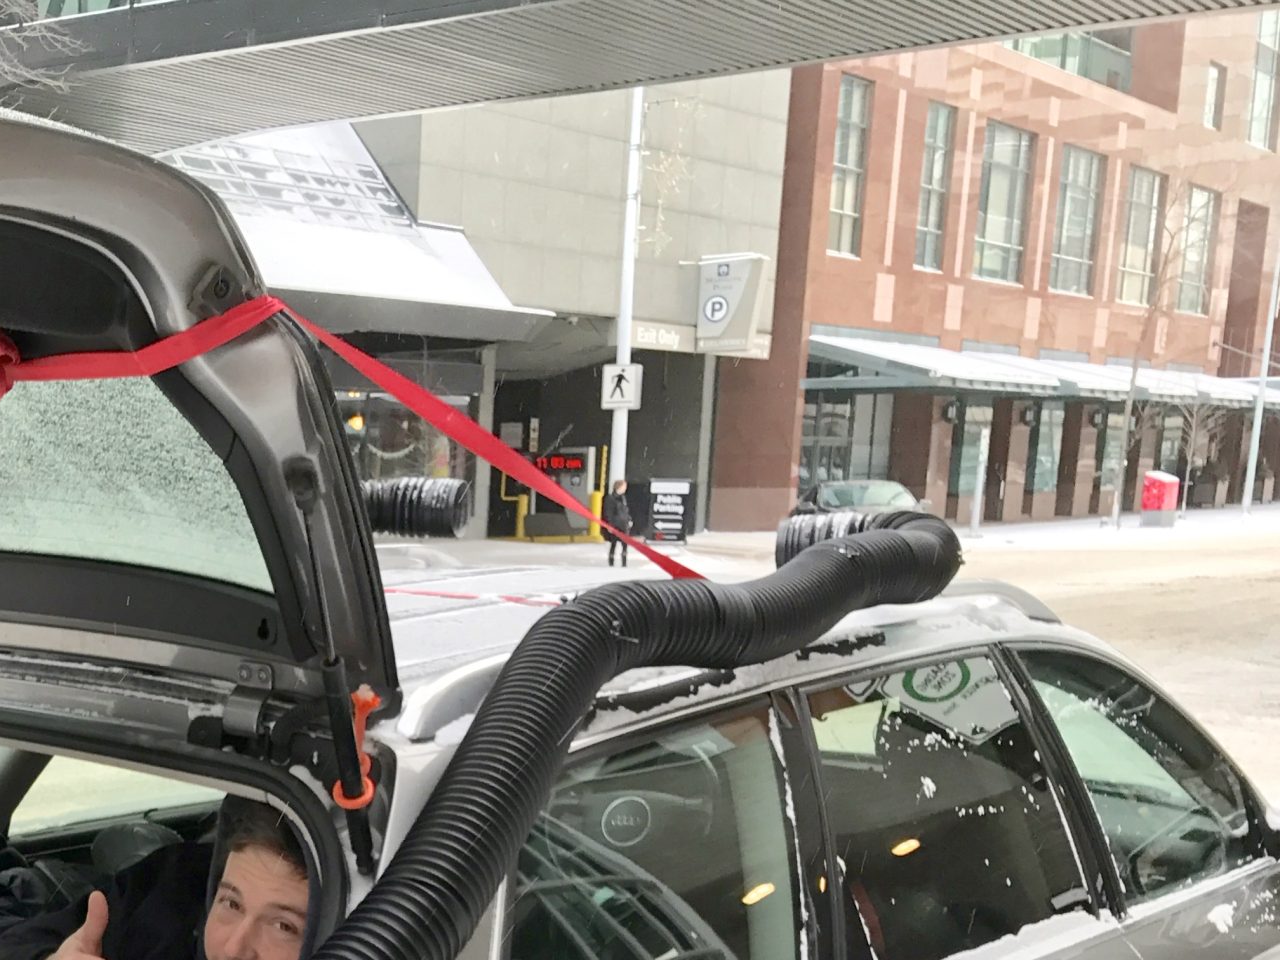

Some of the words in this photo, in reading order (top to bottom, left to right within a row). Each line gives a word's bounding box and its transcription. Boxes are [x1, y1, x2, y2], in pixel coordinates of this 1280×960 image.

[637, 327, 657, 344] Exit
[658, 328, 680, 350] Only
[656, 494, 683, 504] Public
[653, 503, 685, 516] Parking
